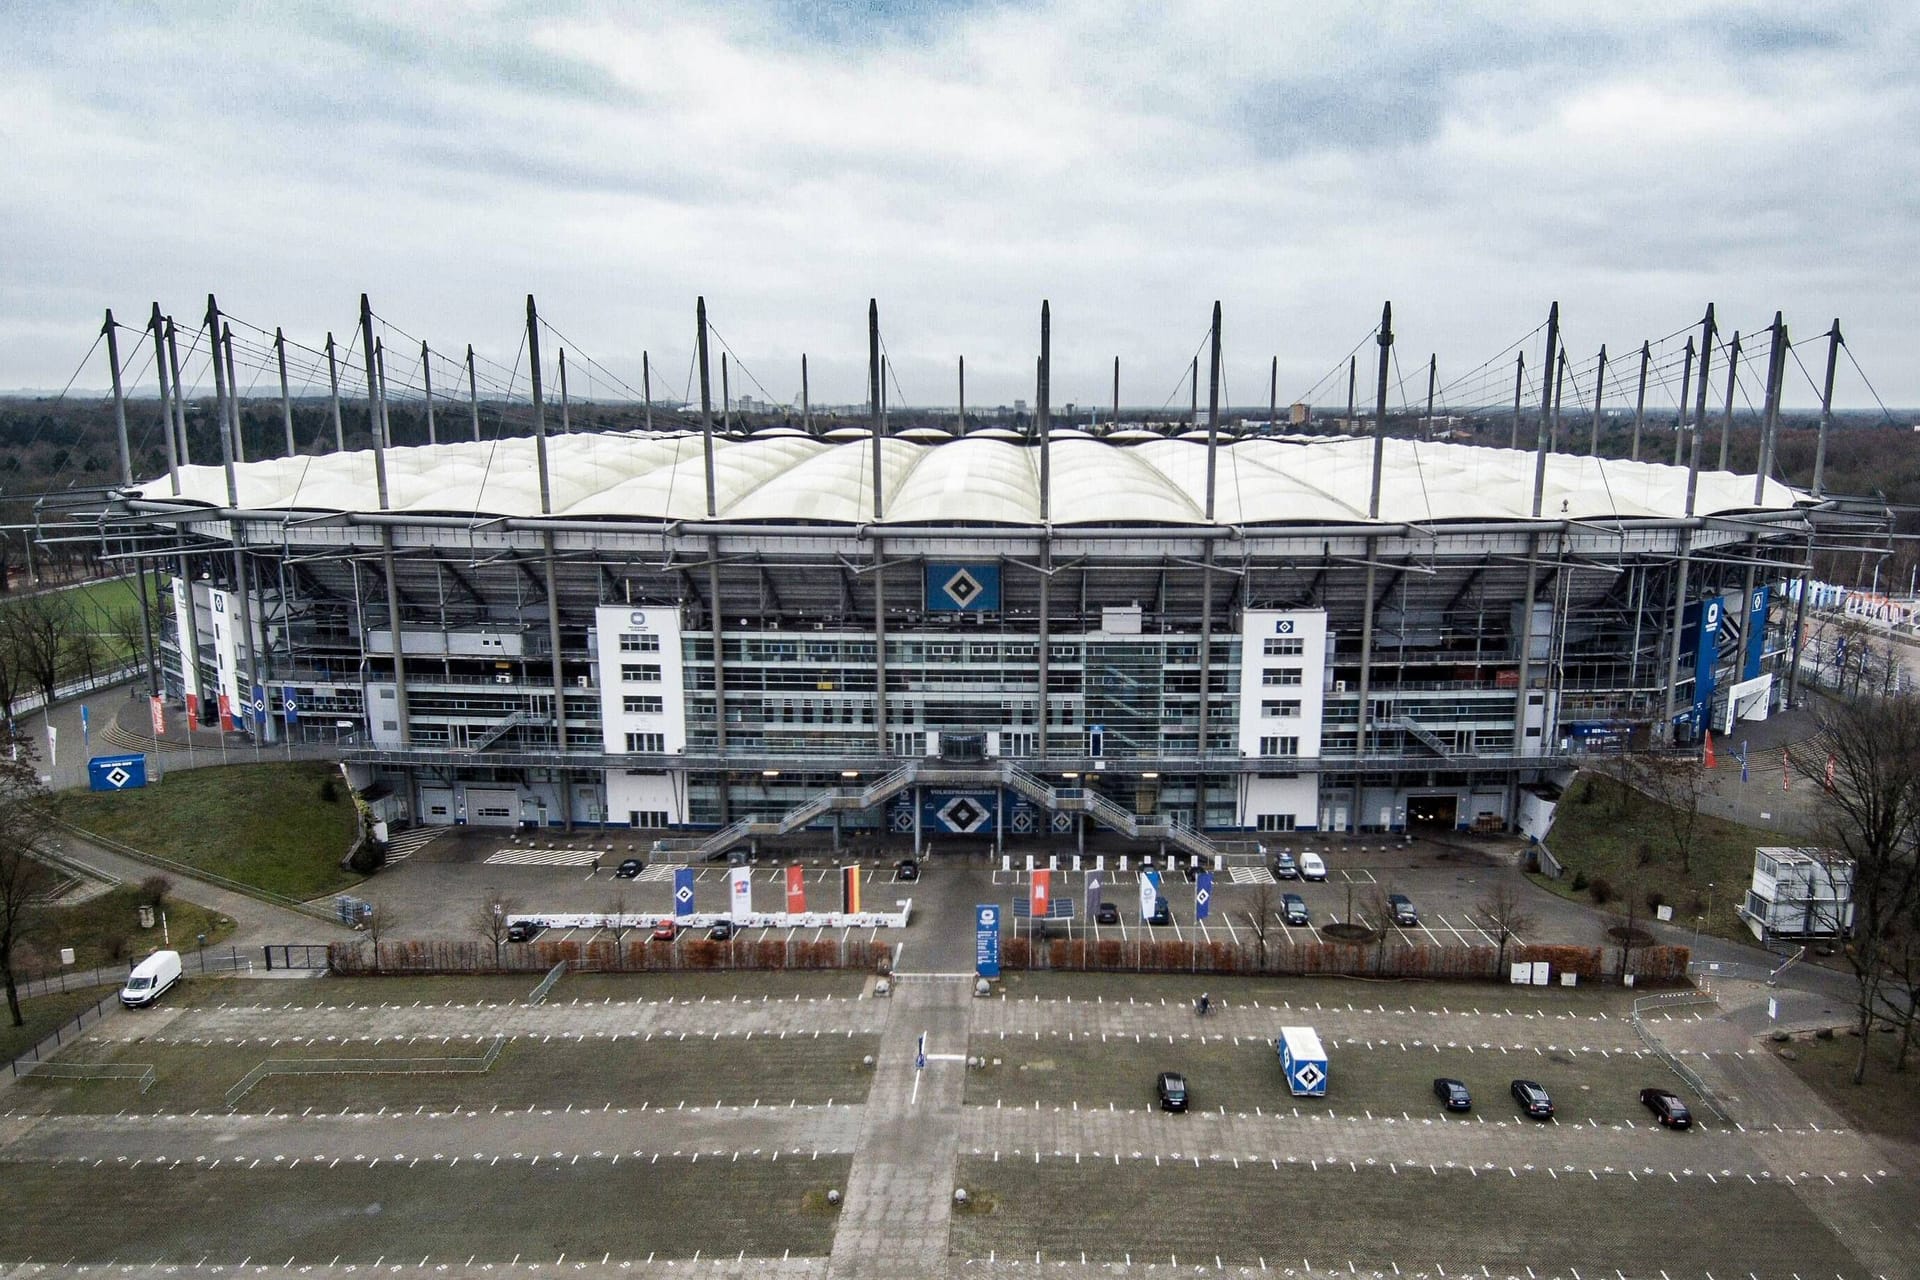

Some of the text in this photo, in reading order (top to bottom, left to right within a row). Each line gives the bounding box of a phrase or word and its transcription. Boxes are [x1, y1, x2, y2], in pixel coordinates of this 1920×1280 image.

[344, 1264, 357, 1274] 22
[390, 1263, 403, 1273] 20
[574, 1261, 587, 1271] 12
[619, 1260, 632, 1270] 10
